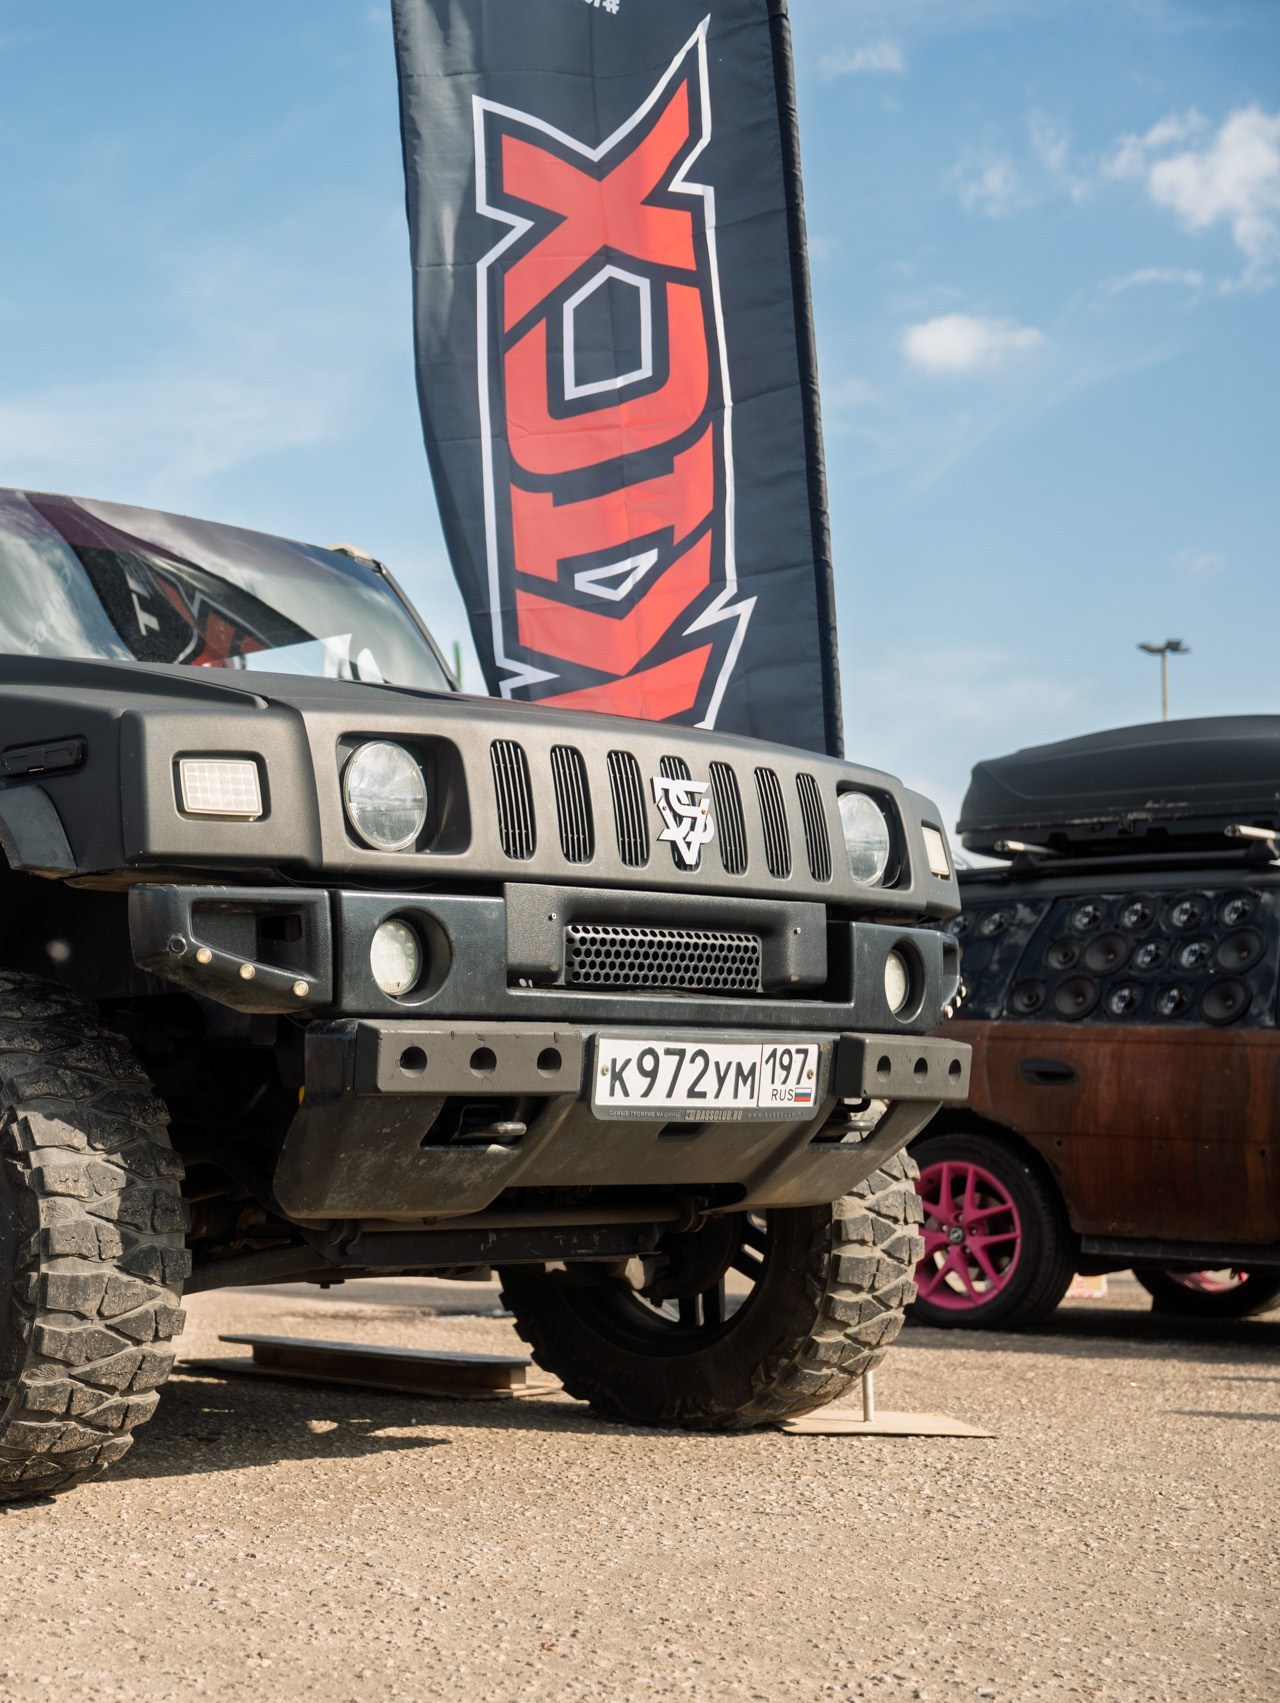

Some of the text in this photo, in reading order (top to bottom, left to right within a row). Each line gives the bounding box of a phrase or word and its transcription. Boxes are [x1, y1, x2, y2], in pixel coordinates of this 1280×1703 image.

[500, 76, 715, 722] KICX
[765, 1047, 809, 1085] 197
[771, 1088, 794, 1101] RUS
[696, 1109, 743, 1121] BASSCLUB.RU
